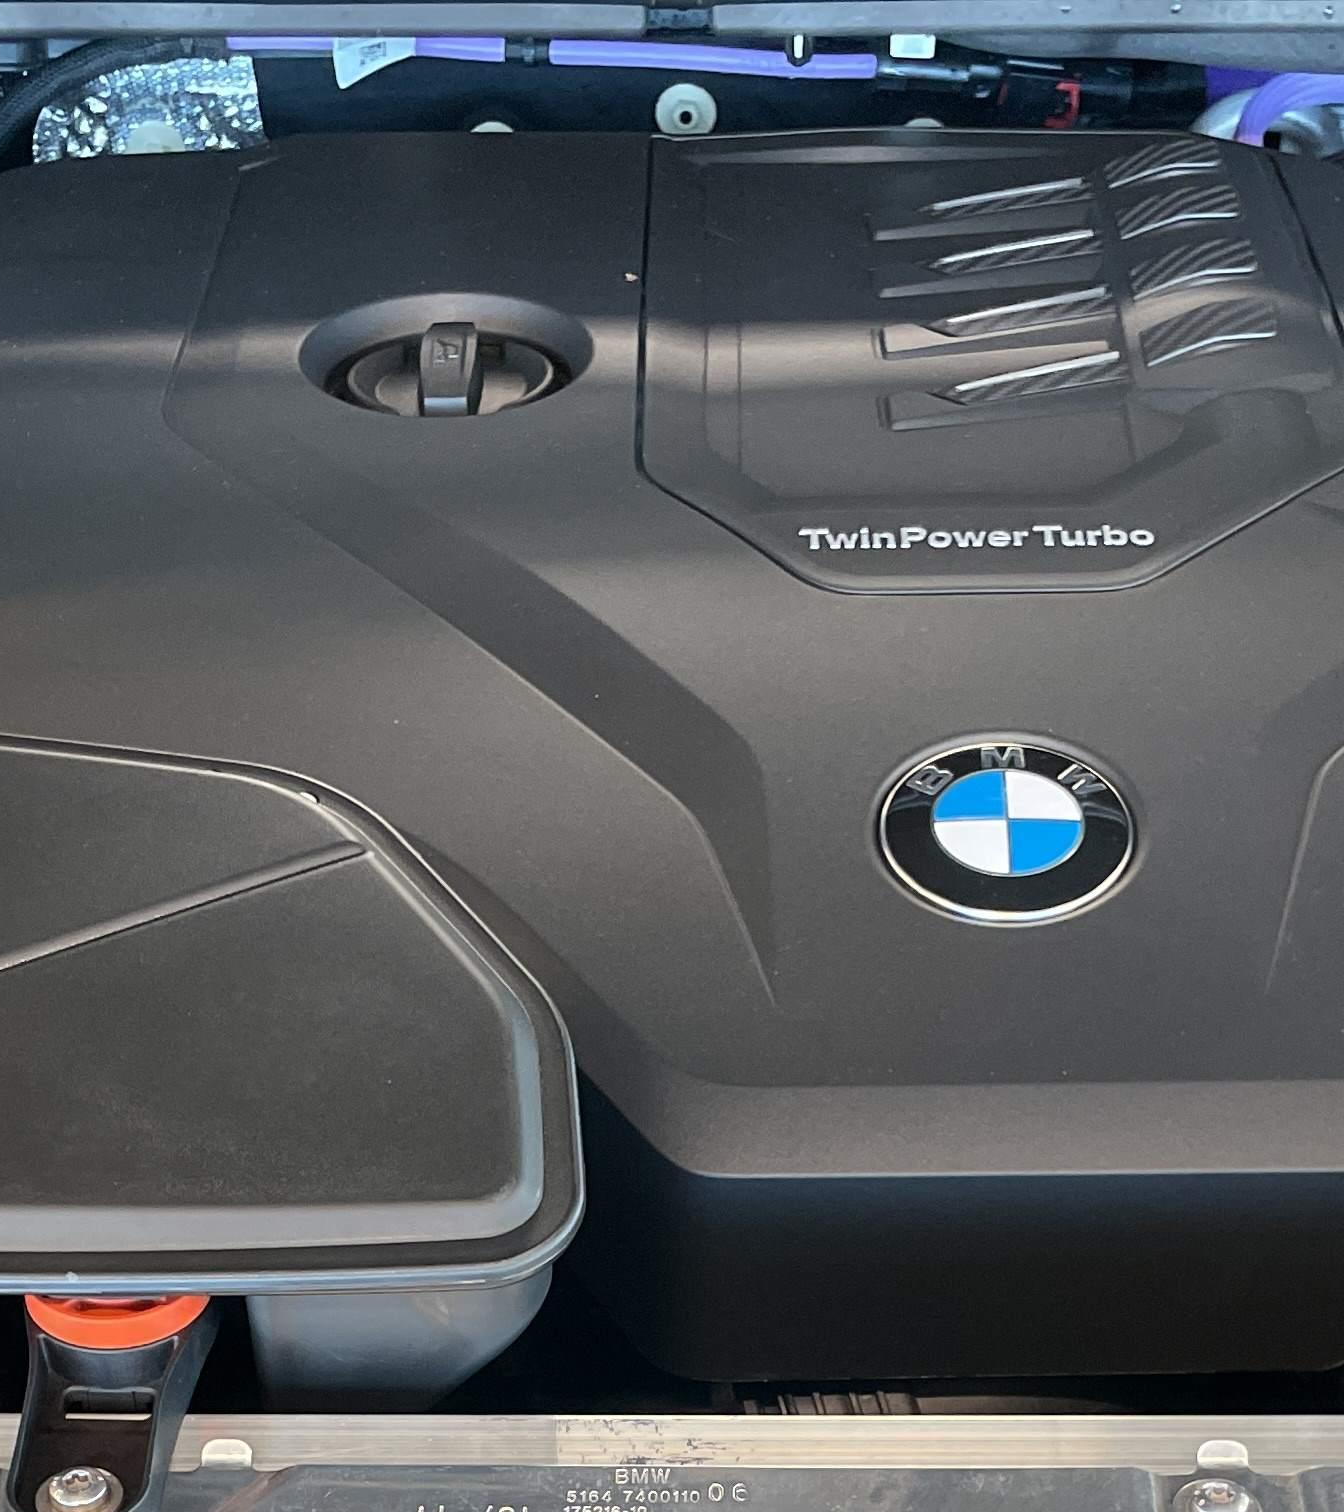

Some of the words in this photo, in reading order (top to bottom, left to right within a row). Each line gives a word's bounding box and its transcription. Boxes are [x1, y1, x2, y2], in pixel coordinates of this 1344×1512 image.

[798, 526, 1029, 550] TwinPower
[1032, 524, 1155, 548] Turbo
[906, 745, 1107, 797] BMW
[614, 1467, 671, 1485] BMW
[566, 1490, 612, 1504] 5164
[623, 1489, 700, 1504] 7400110
